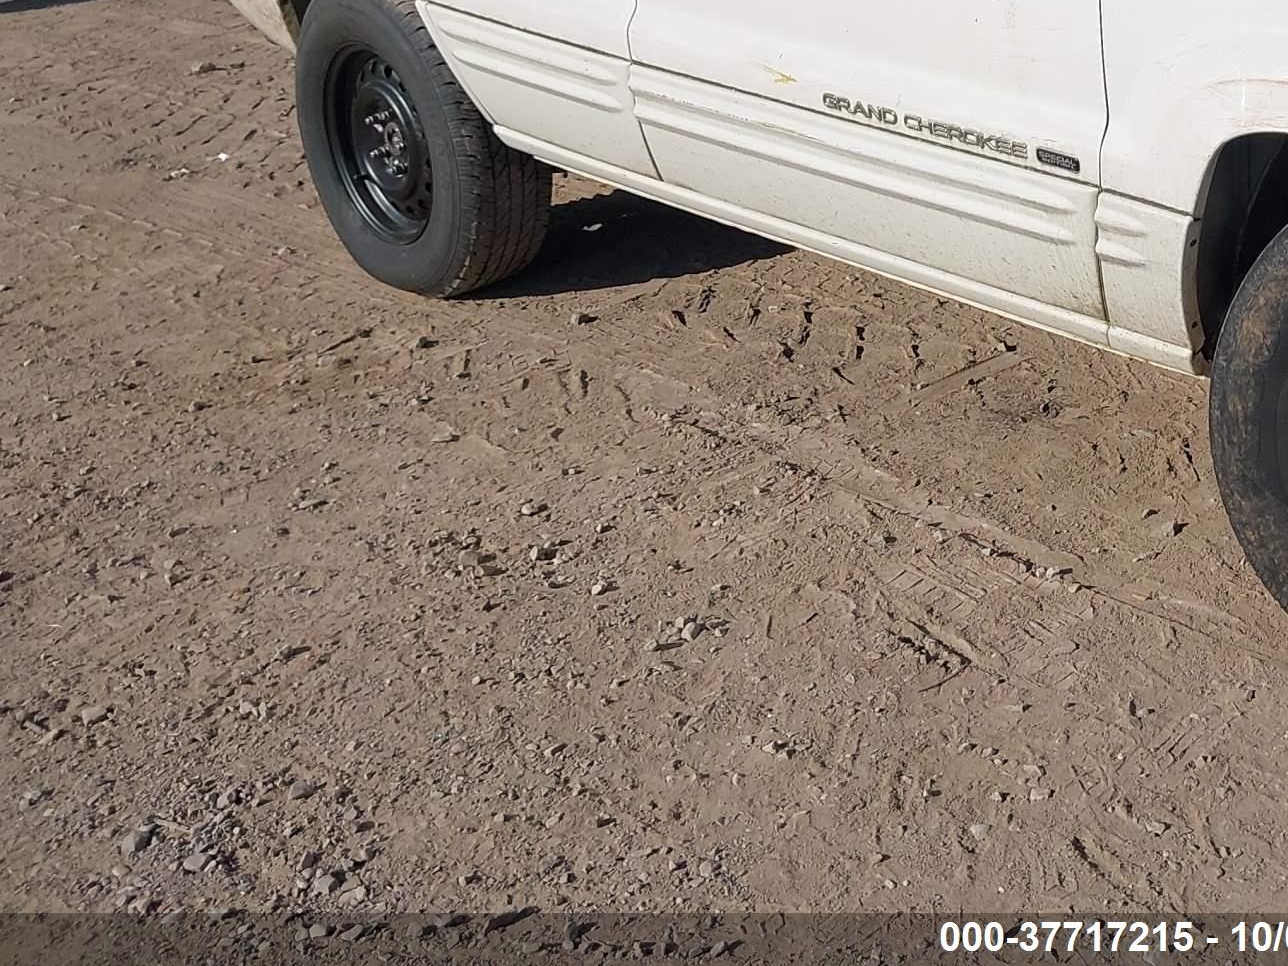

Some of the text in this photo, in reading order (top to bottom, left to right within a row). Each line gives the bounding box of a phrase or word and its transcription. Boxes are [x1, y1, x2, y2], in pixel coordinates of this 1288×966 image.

[822, 92, 1028, 159] GRAND CHEROKEE
[1038, 150, 1074, 165] SPECIAL
